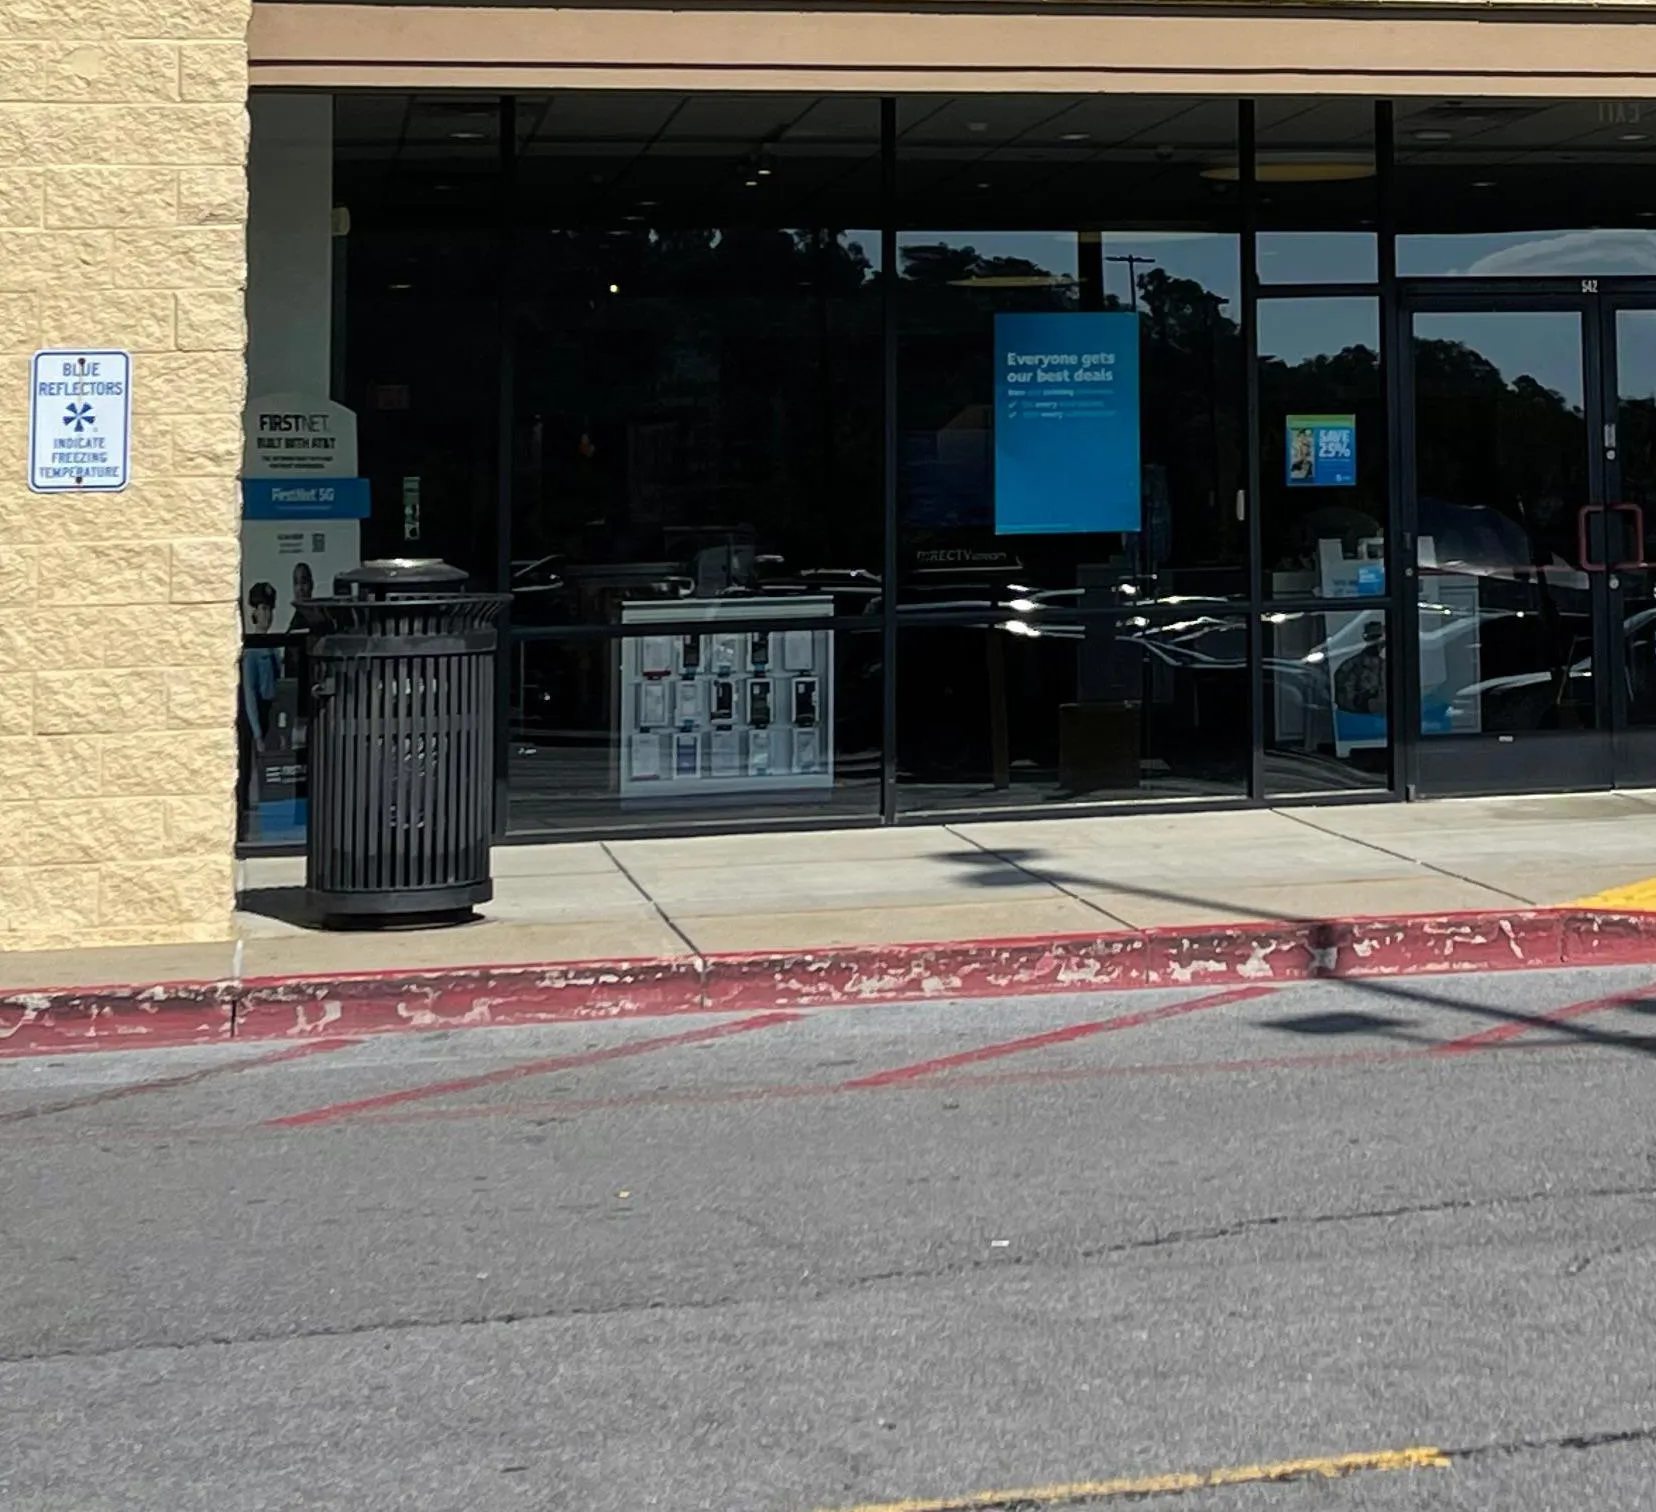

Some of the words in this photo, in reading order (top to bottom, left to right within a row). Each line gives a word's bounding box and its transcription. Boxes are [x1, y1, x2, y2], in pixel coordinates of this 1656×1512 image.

[1006, 352, 1079, 368] Everyone
[1081, 352, 1116, 368] gets
[62, 362, 101, 377] BLUE
[1006, 371, 1034, 383] our
[1035, 368, 1071, 383] best
[1073, 368, 1114, 382] deals
[38, 381, 123, 396] REFLECTORS
[1319, 430, 1351, 442] SAVE
[53, 437, 106, 449] INDICATE
[311, 437, 337, 449] AT&T
[51, 452, 108, 464] FREEZING
[39, 466, 120, 479] TEMPERATURE
[271, 488, 317, 502] FirstNet
[318, 488, 335, 502] 5G
